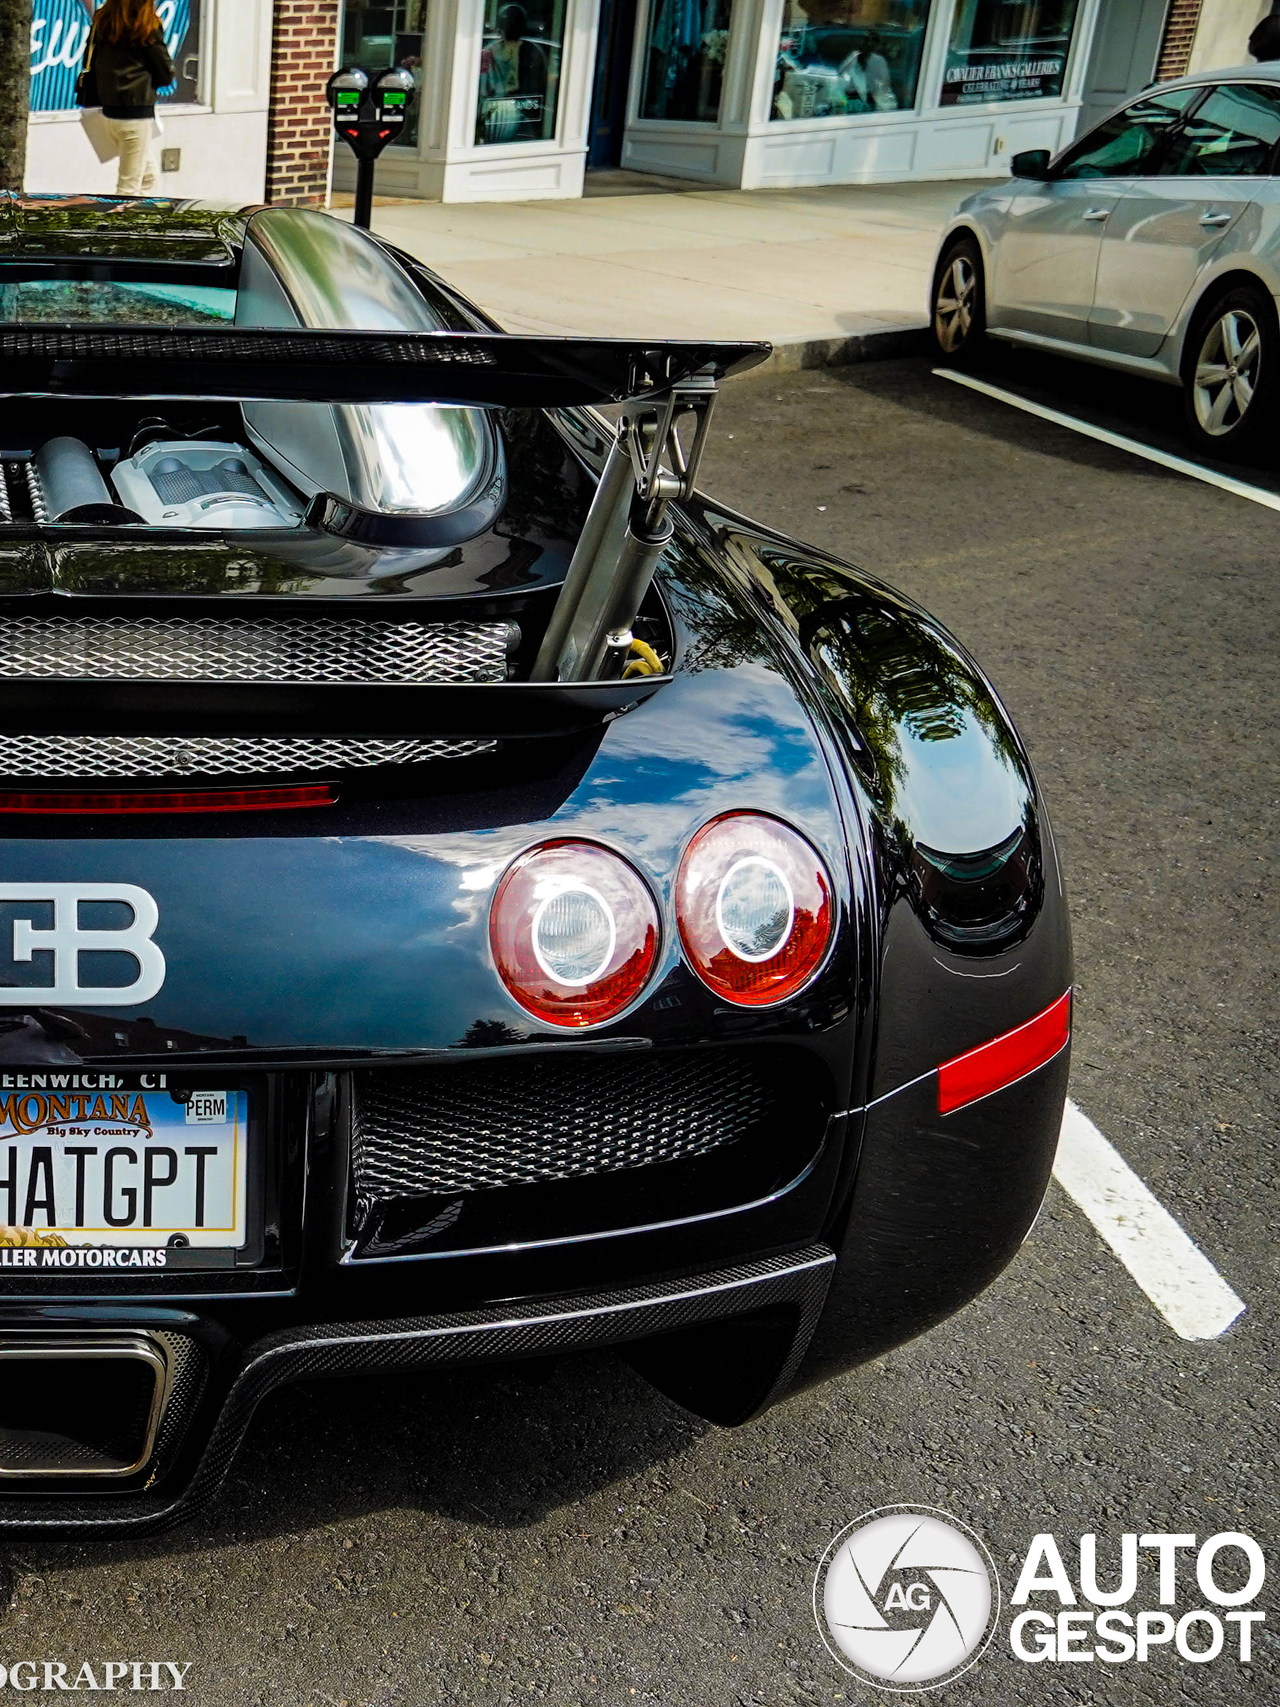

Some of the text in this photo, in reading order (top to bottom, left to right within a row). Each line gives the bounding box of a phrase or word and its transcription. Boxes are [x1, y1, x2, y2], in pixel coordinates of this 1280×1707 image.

[186, 1098, 225, 1116] PERM
[46, 1127, 141, 1138] Big Sky Country
[41, 1249, 167, 1267] MOTORCARS
